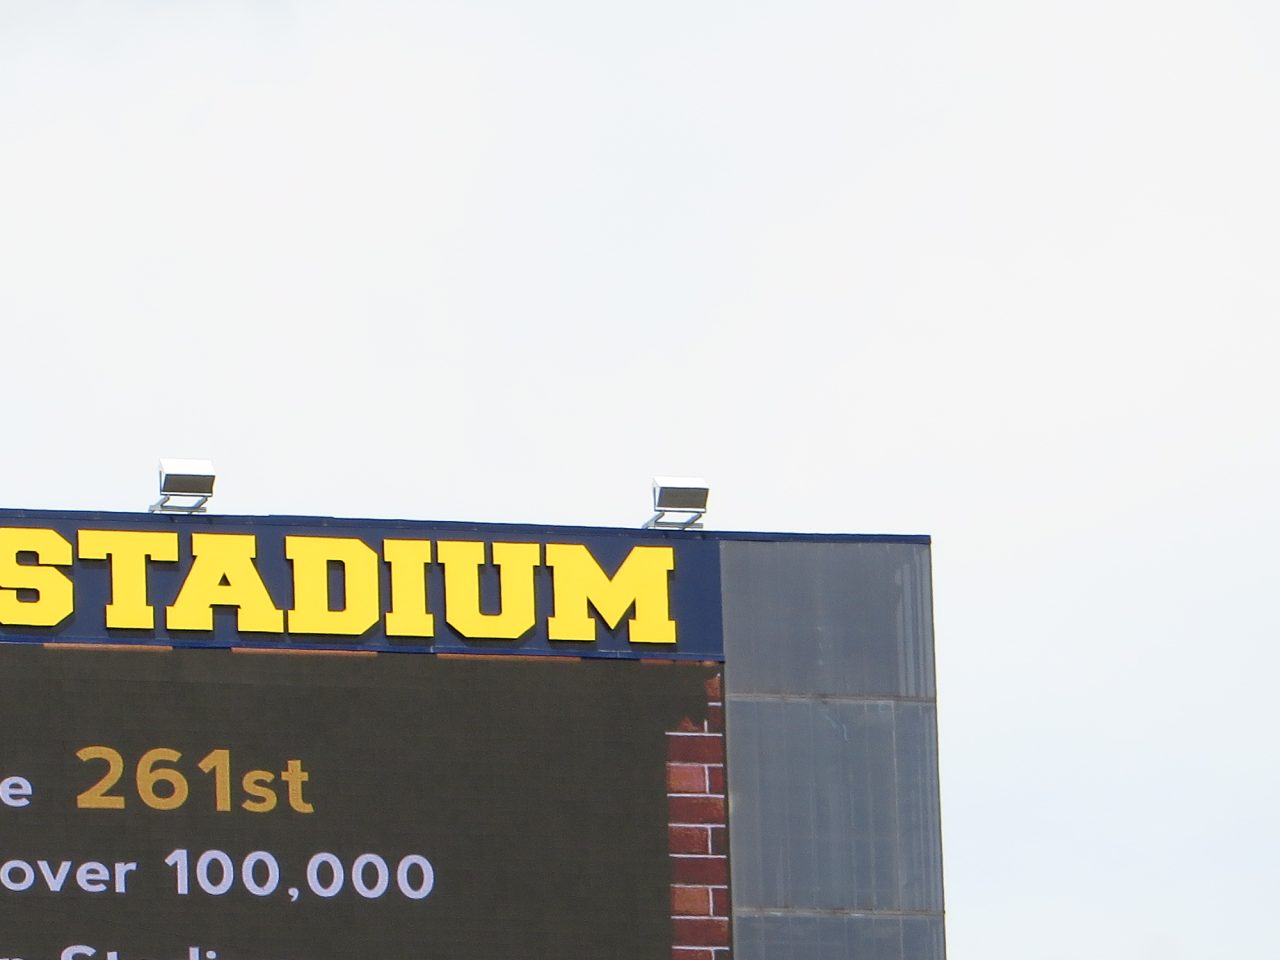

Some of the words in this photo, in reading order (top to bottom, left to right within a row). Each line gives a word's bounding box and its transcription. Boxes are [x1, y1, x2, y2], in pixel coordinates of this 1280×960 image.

[75, 745, 314, 814] 261st
[0, 859, 137, 893] over
[164, 848, 435, 902] 100,000
